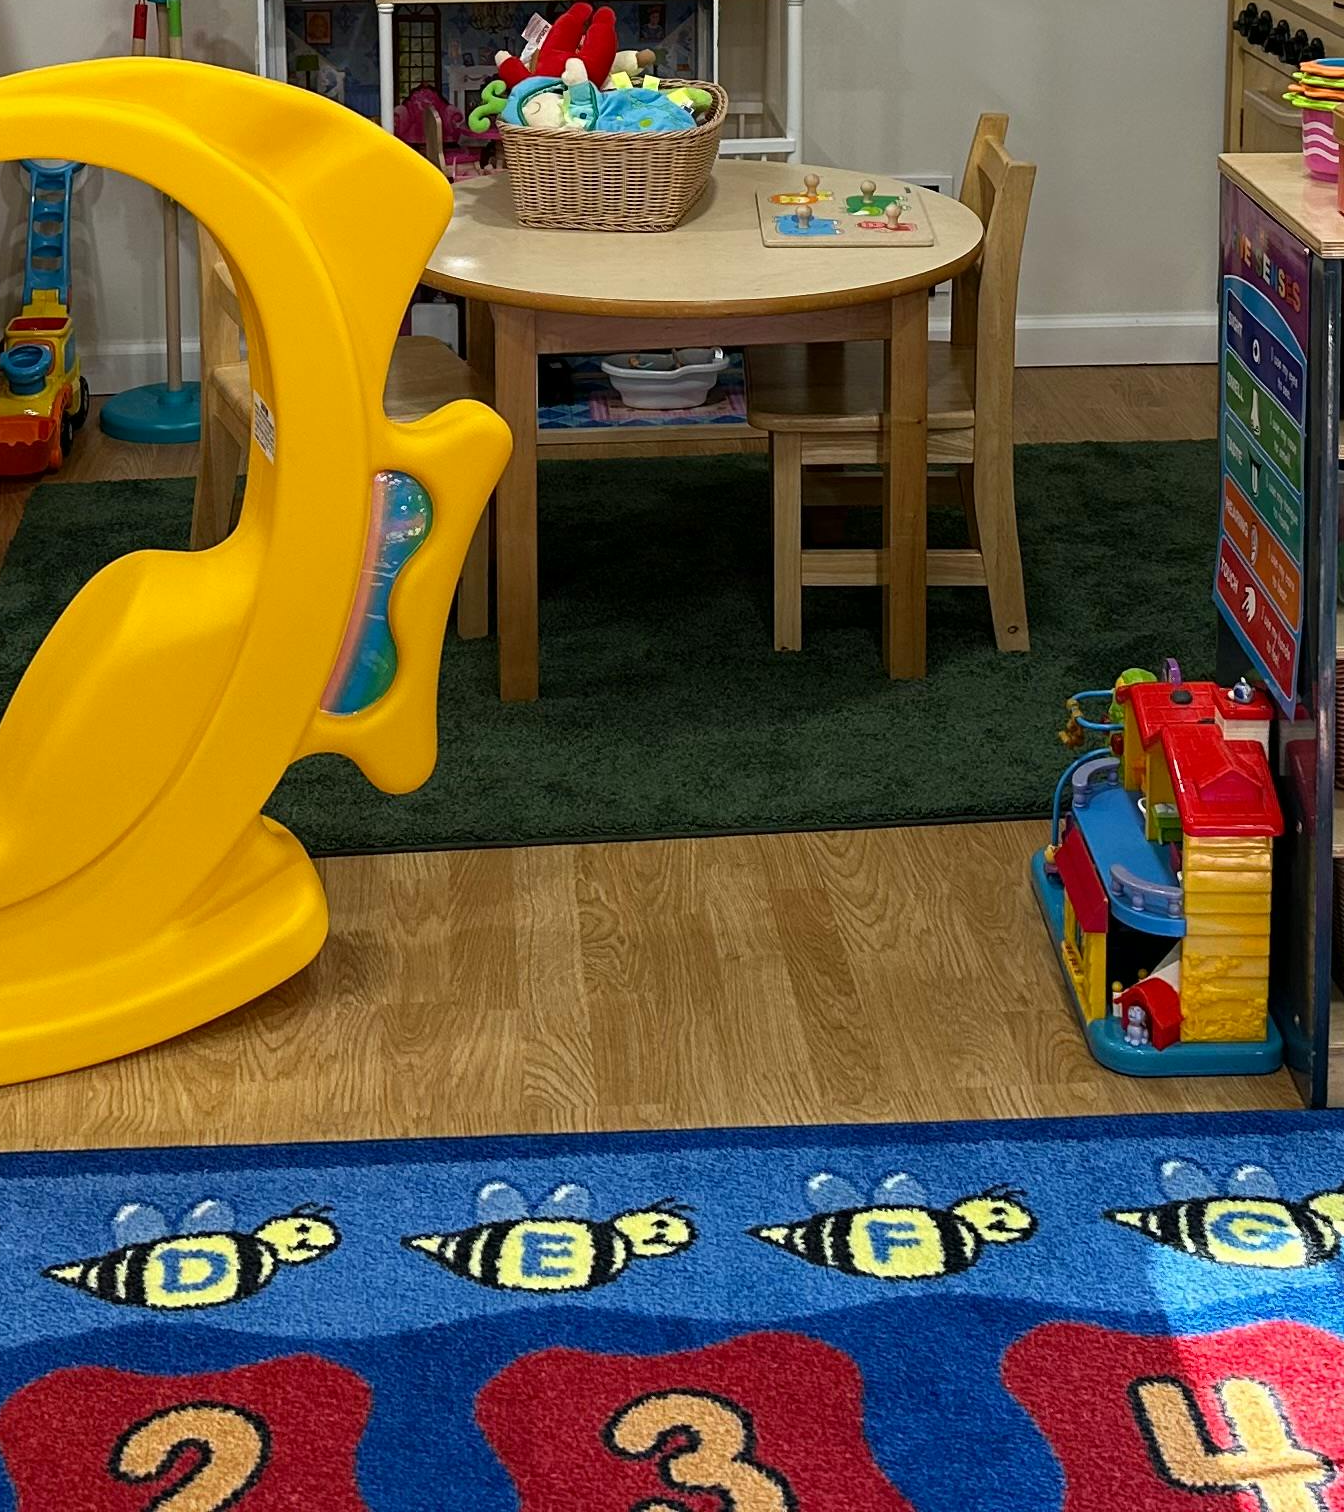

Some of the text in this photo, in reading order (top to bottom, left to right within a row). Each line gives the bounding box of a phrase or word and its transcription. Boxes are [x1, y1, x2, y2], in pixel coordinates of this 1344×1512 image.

[1256, 250, 1301, 312] SENSES
[1227, 371, 1244, 402] SMELL
[1221, 557, 1238, 595] TOUCH
[869, 1220, 925, 1264] F
[1203, 1209, 1278, 1248] G
[159, 1248, 229, 1294] D
[522, 1229, 583, 1278] E
[109, 1399, 273, 1512] 2
[600, 1387, 802, 1512] 3
[1126, 1374, 1340, 1512] 4
